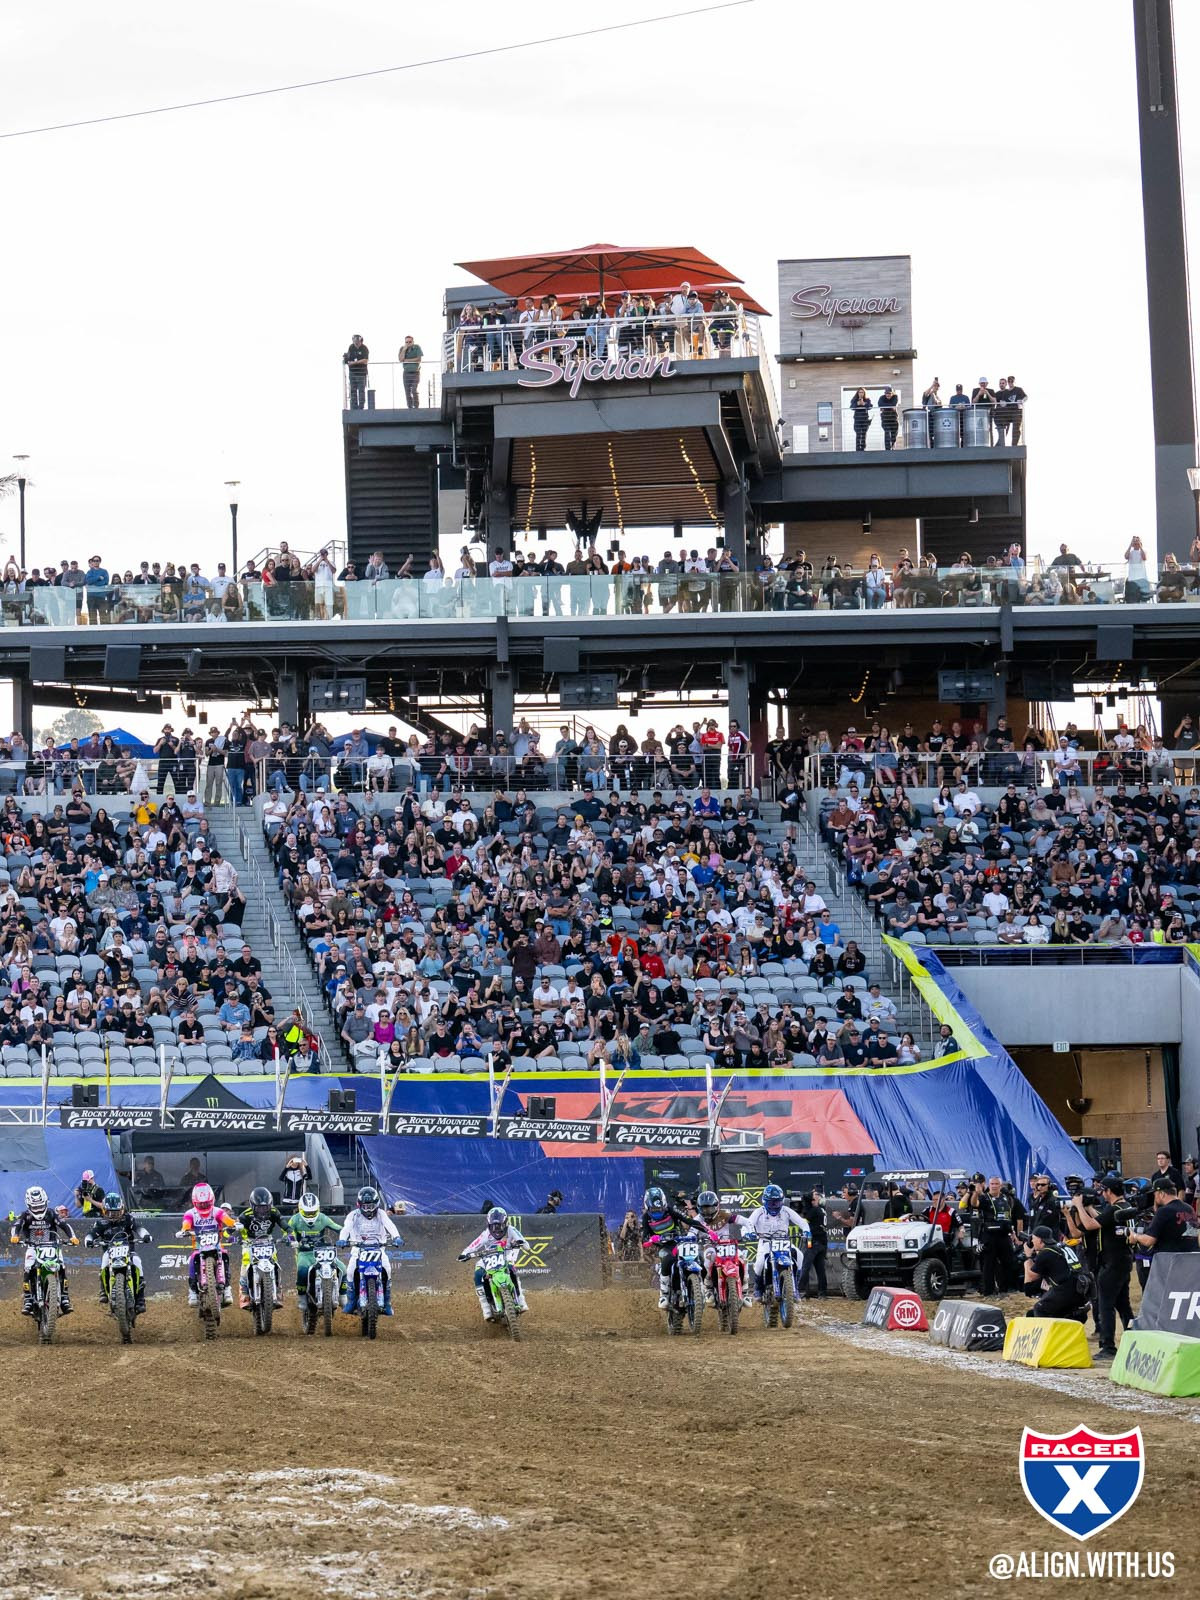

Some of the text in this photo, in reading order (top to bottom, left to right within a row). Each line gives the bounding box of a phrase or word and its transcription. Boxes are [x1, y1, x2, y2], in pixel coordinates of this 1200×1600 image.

[790, 284, 901, 326] Sycuan
[517, 339, 677, 398] Sycuan
[224, 1112, 266, 1120] MOUNTAIN
[330, 1115, 372, 1123] MOUNTAIN
[438, 1118, 480, 1126] MOUNTAIN
[520, 1121, 591, 1131] ROCKY MOUNTAIN
[658, 1128, 700, 1136] MOUNTAIN
[720, 1191, 762, 1208] SMX
[200, 1234, 218, 1246] 260
[772, 1241, 790, 1250] 512
[40, 1247, 56, 1258] 70
[678, 1243, 698, 1256] 113
[1064, 1246, 1080, 1264] 20
[316, 1250, 334, 1262] 310
[359, 1250, 382, 1262] 877
[486, 1254, 504, 1268] 284
[900, 1307, 916, 1318] RM
